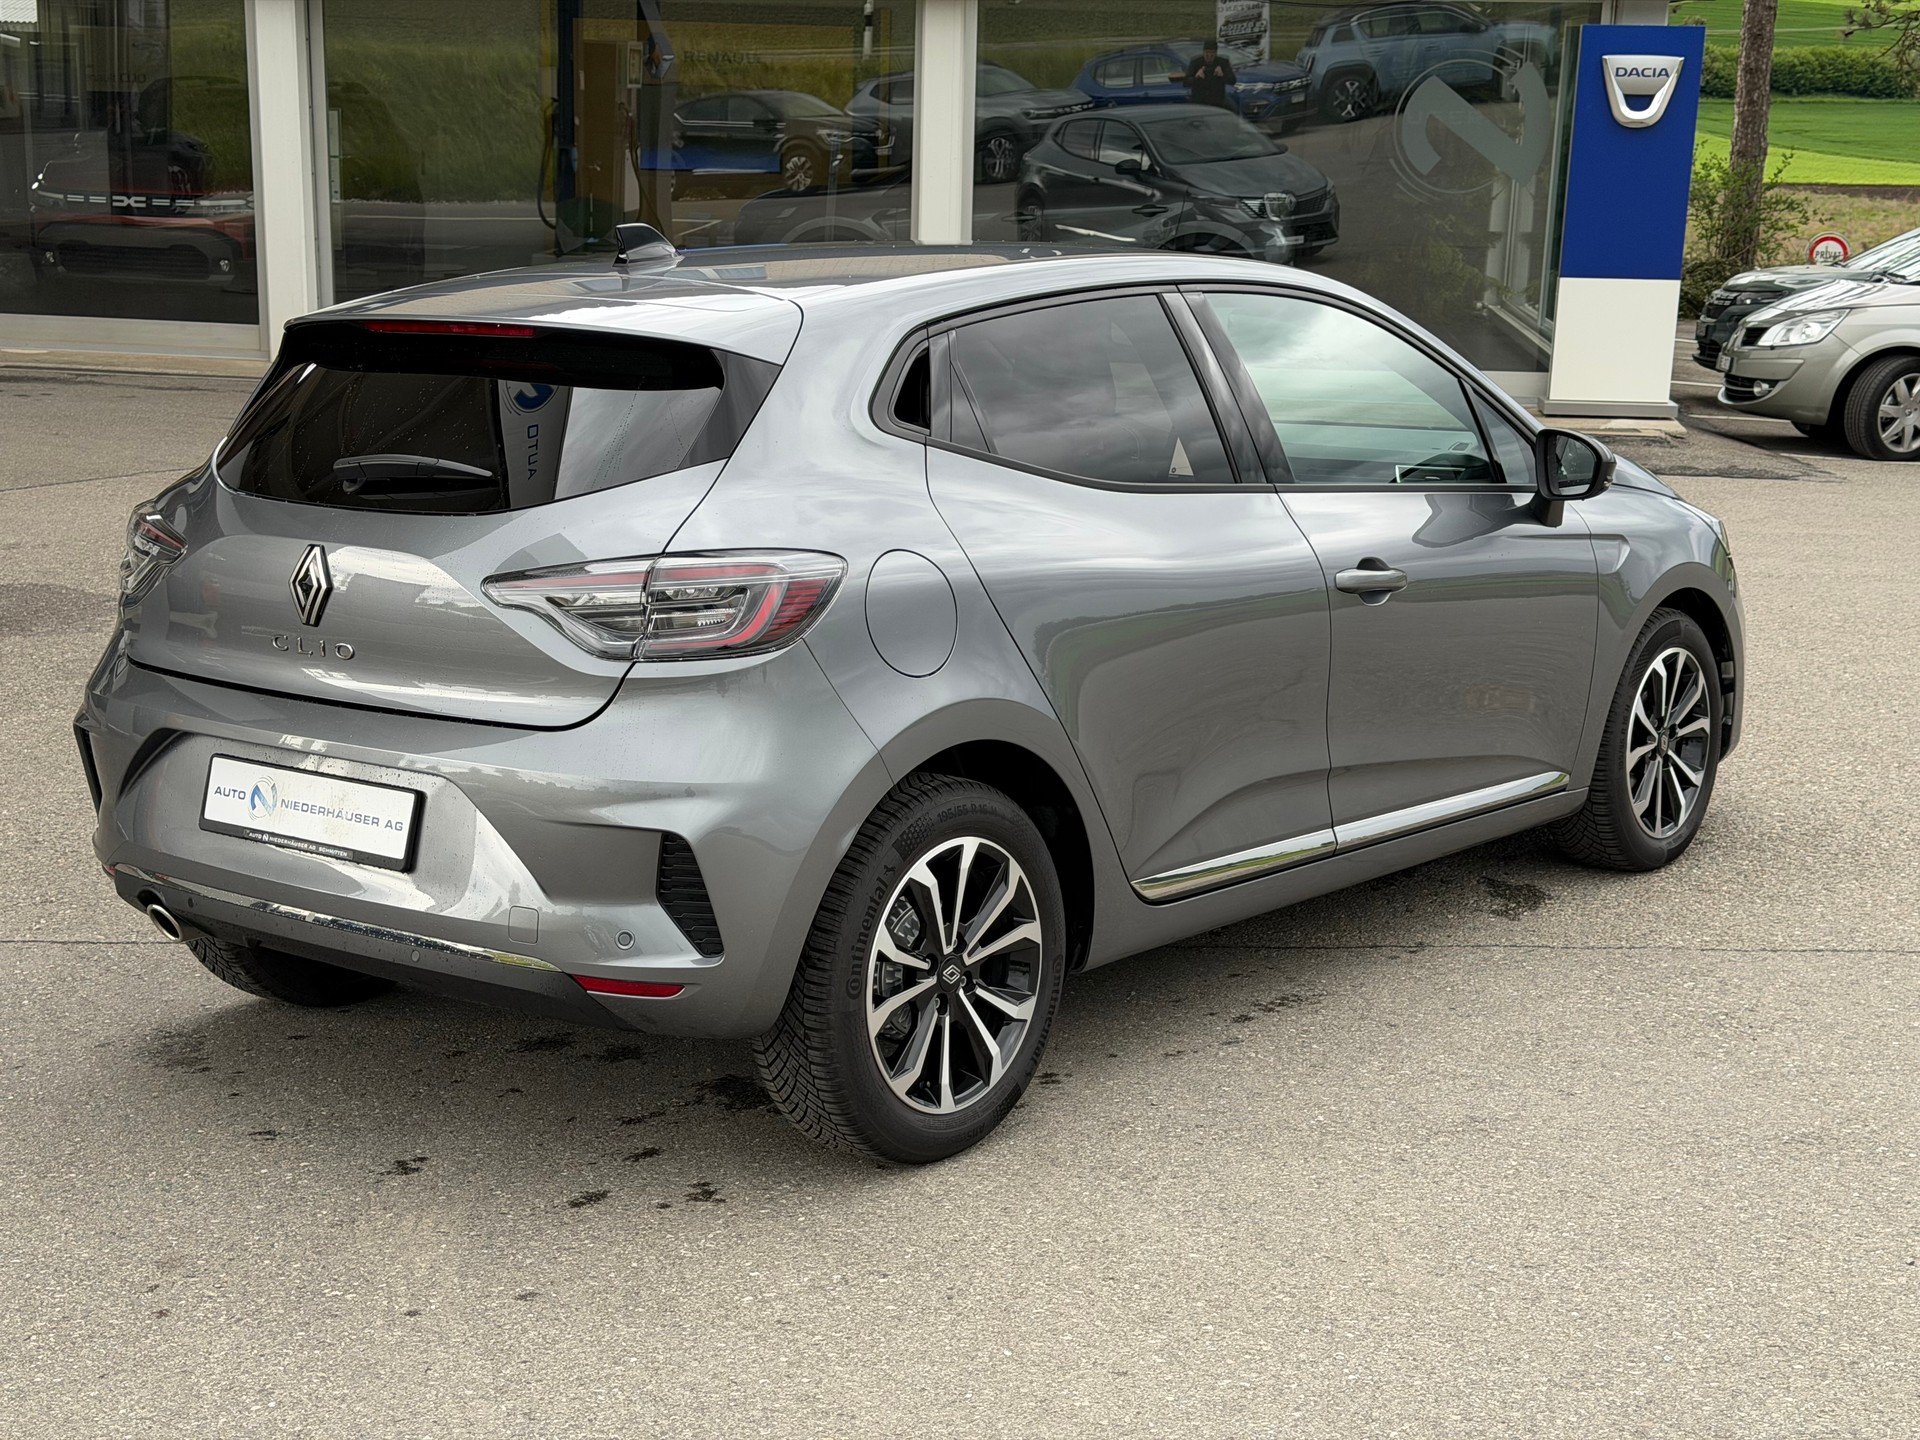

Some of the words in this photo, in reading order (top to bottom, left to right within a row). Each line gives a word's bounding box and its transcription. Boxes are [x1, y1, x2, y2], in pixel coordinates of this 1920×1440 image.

[1615, 67, 1670, 78] DACIA
[272, 635, 355, 660] CLIO
[214, 786, 247, 800] AUTO
[280, 798, 380, 827] NIEDERHÄUSER
[384, 819, 404, 831] AG
[249, 832, 262, 840] AUTO
[846, 877, 888, 999] Continental
